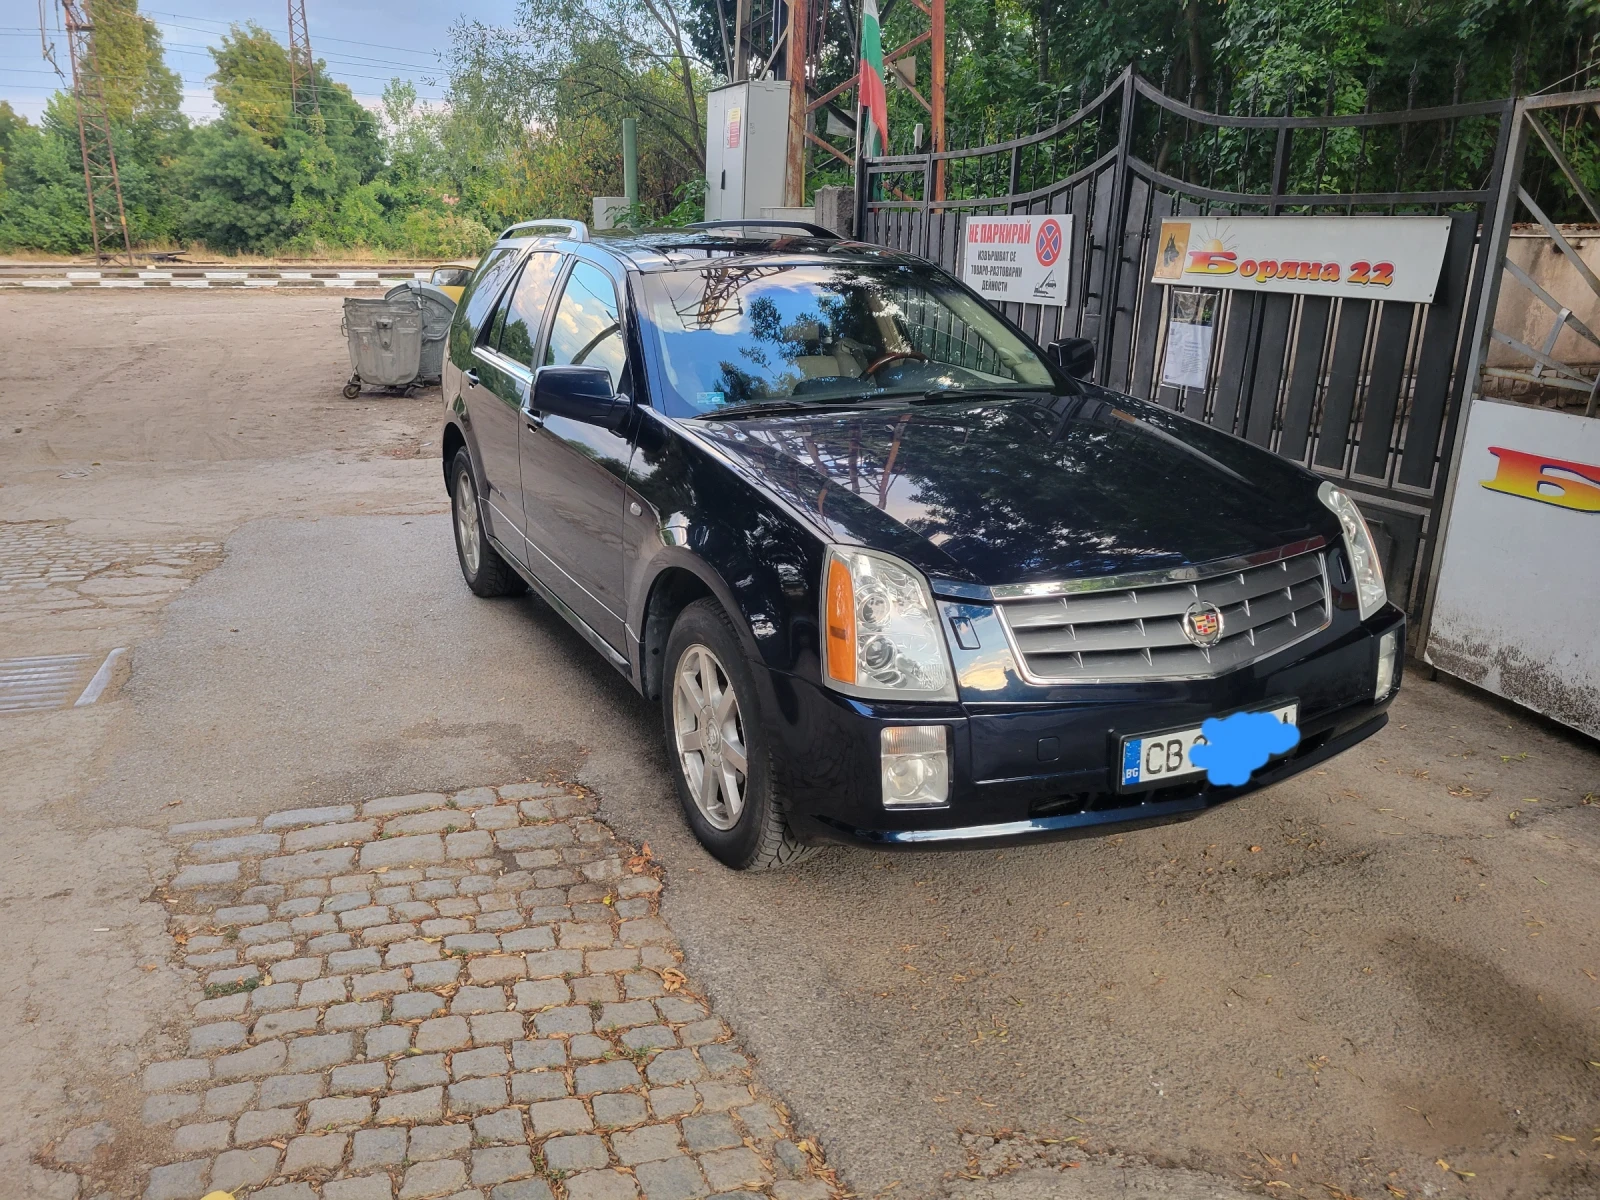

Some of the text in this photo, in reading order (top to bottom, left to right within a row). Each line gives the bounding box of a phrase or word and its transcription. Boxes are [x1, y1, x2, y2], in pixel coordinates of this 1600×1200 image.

[969, 219, 1031, 244] НЕ ПАРКИРАЙ
[978, 250, 1017, 262] ИЗВЪРШВАТ СЕ
[1185, 250, 1395, 286] Боряна 22
[981, 278, 1008, 292] ДЕЙНОСТИ
[1145, 739, 1183, 775] CB
[1126, 767, 1139, 779] BG
